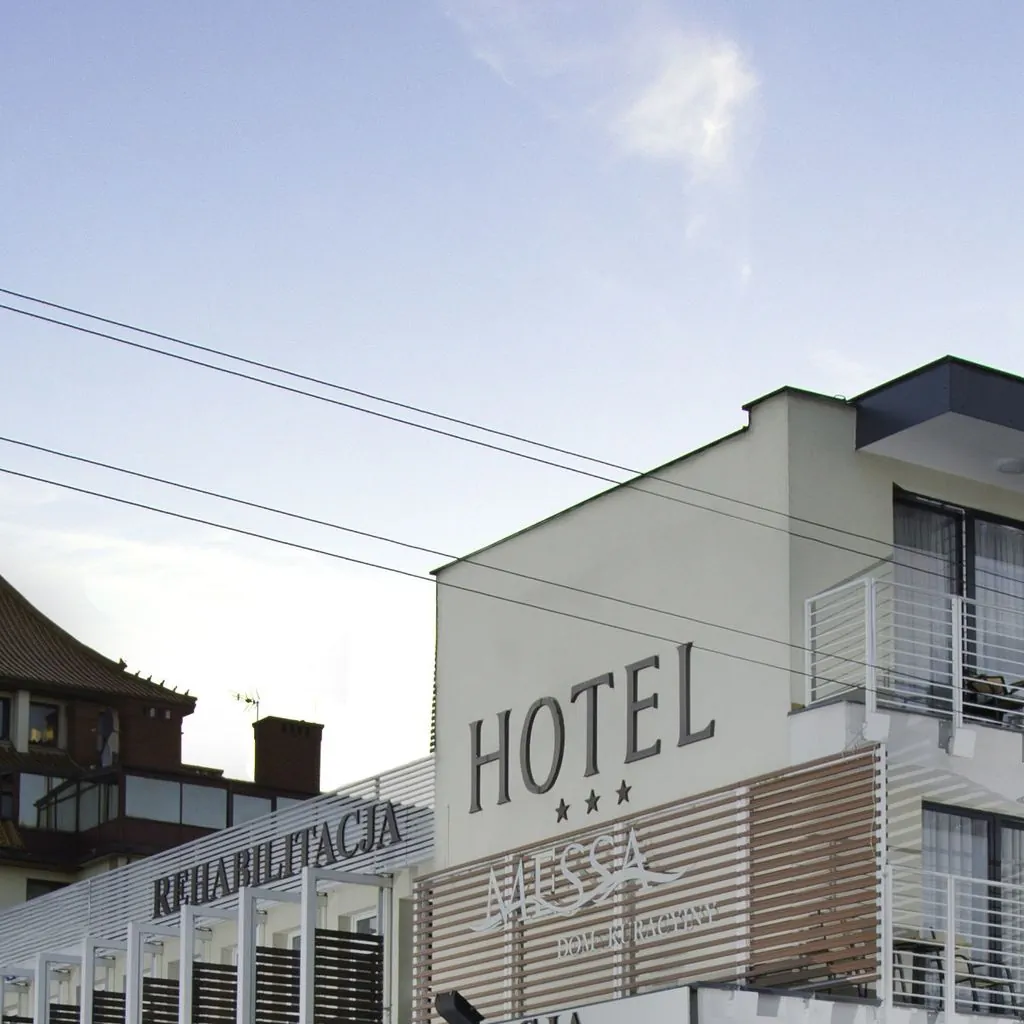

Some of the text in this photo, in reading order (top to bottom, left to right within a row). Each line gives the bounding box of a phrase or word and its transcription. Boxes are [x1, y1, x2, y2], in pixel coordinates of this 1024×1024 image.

[469, 642, 715, 814] HOTEL
[152, 799, 402, 919] REHABILITACJA
[470, 826, 690, 934] MESSA
[556, 930, 596, 959] DOM
